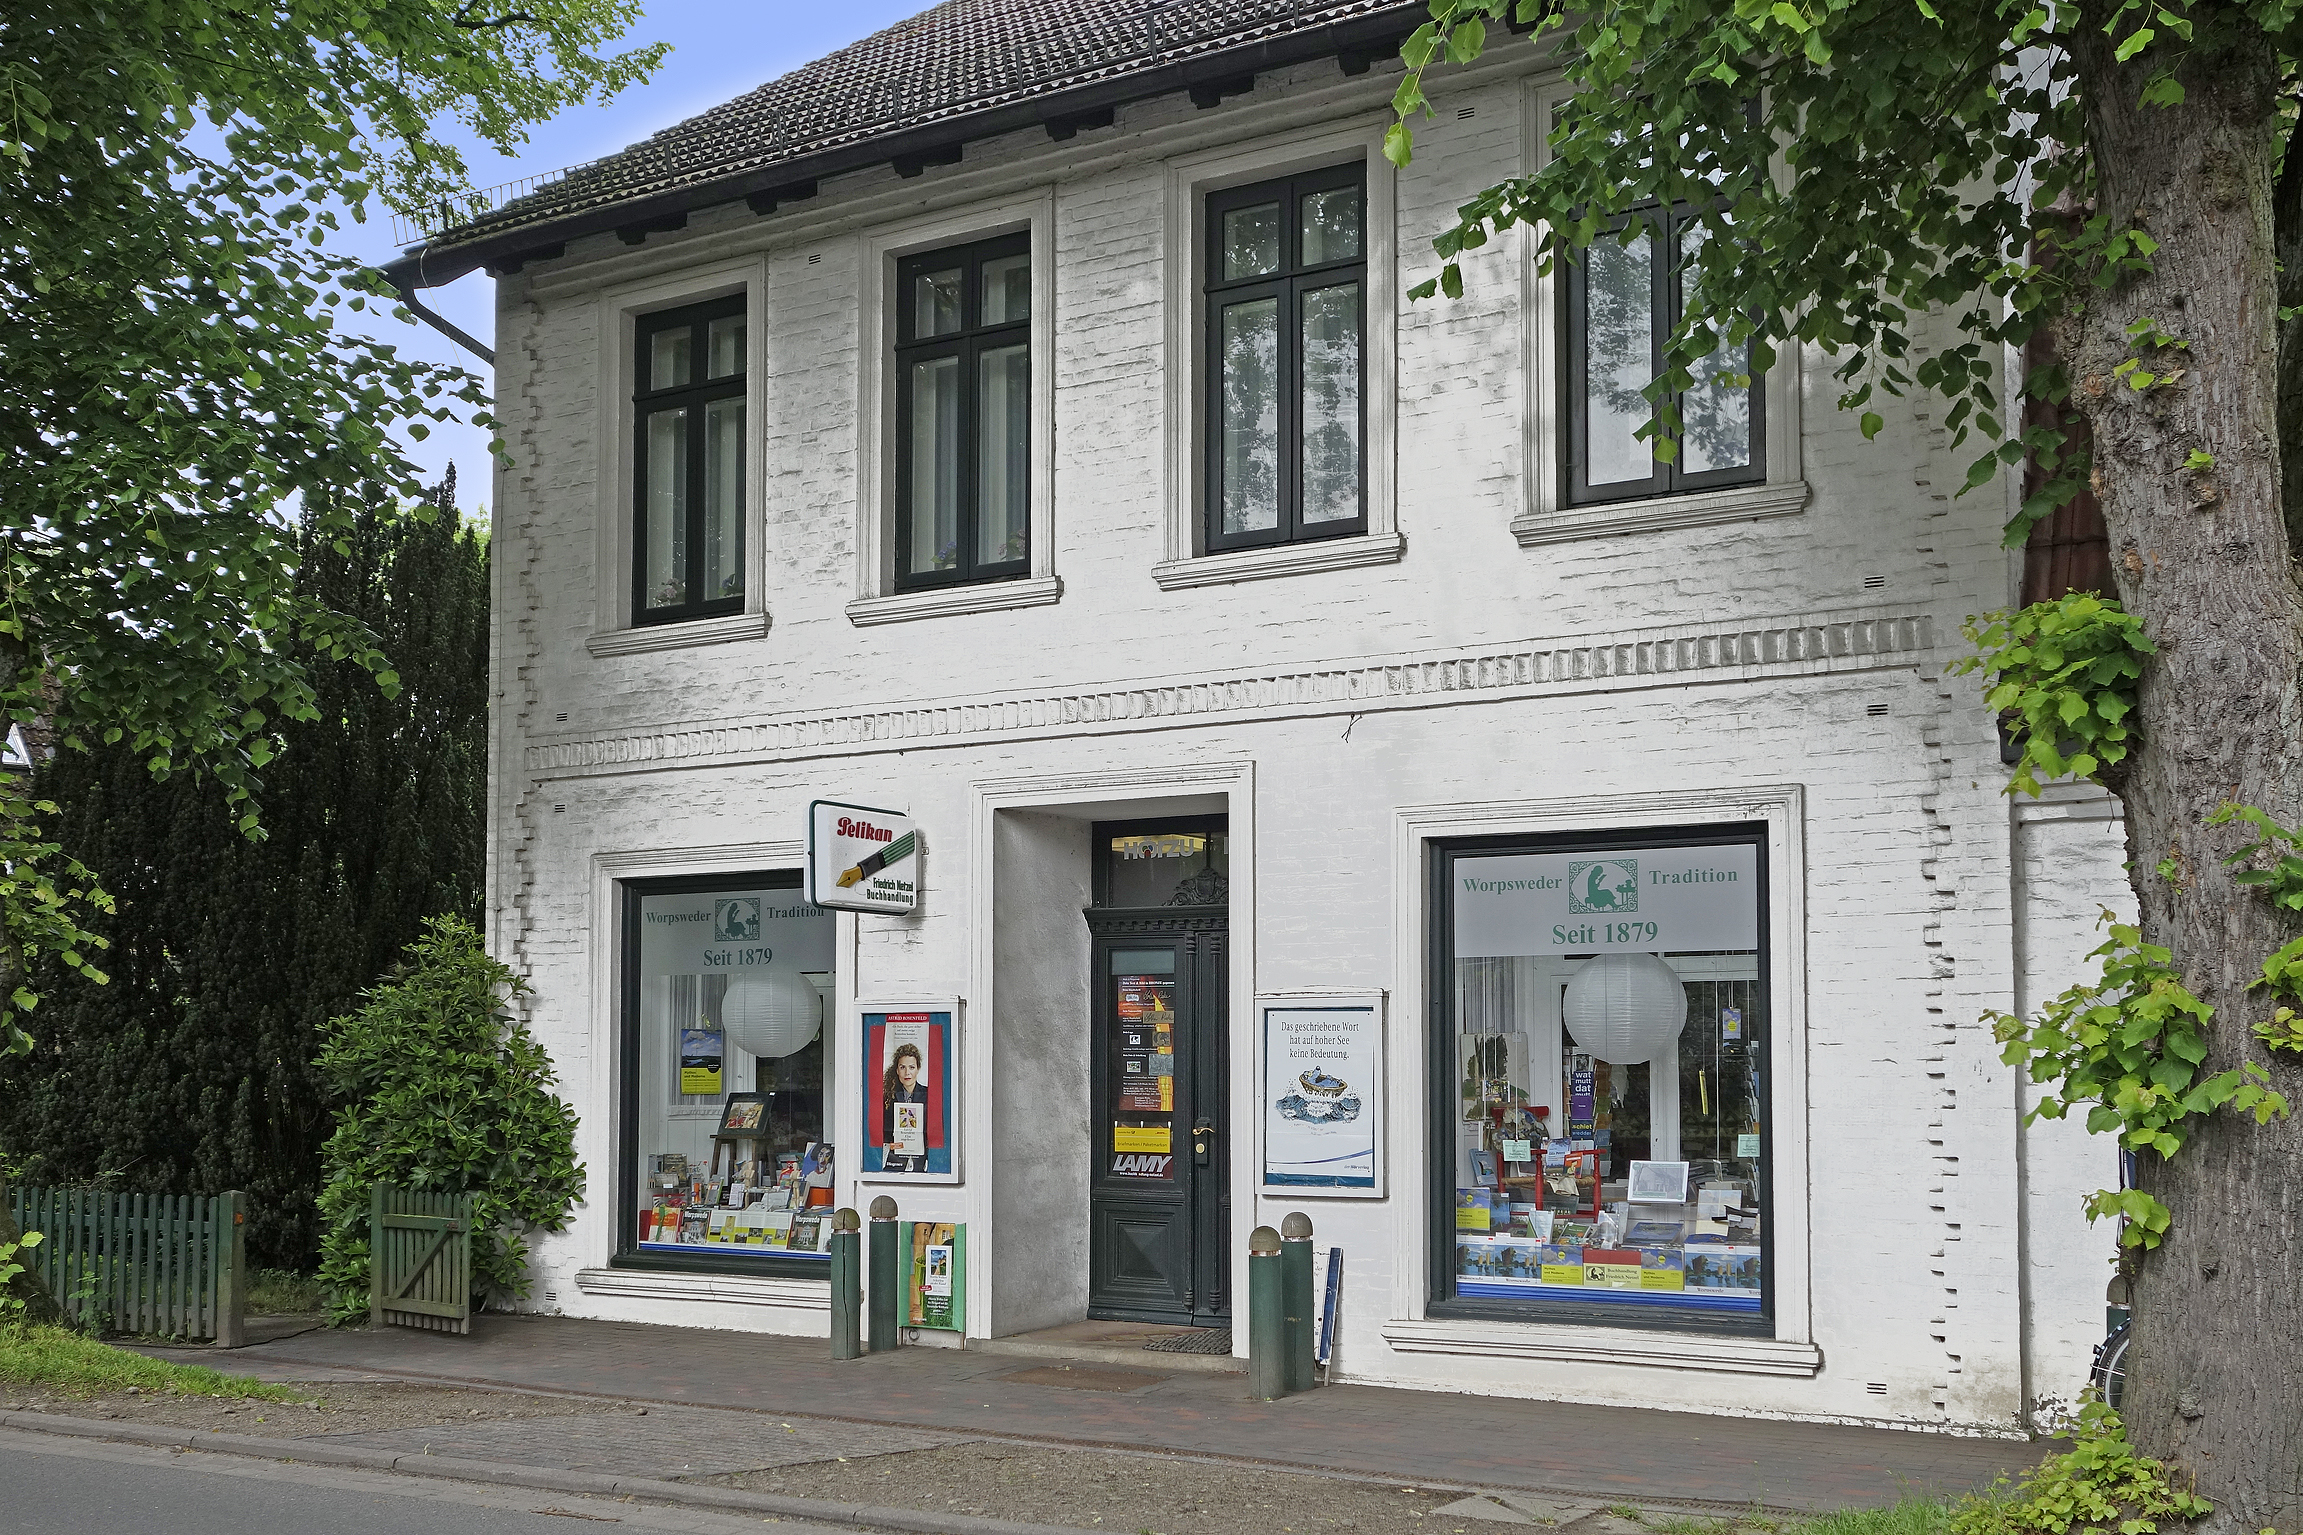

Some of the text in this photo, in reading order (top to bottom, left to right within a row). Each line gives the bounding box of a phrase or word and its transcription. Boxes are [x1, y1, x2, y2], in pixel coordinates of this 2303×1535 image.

[837, 816, 893, 842] Pelikan
[873, 877, 896, 890] Friedrich
[1463, 868, 1738, 895] Worpsweder Tradition
[866, 888, 914, 906] Buchhandlung
[646, 903, 825, 926] Worpsweder Tradition
[1552, 921, 1659, 945] Seit 1879
[703, 948, 773, 966] Seit 1879
[1281, 1021, 1360, 1033] Das geschriebene Wort
[1289, 1034, 1350, 1045] hat auf hoher See
[1289, 1048, 1350, 1060] keine Bedeutung.
[1575, 1084, 1591, 1092] dat
[1112, 1154, 1173, 1173] LAMY
